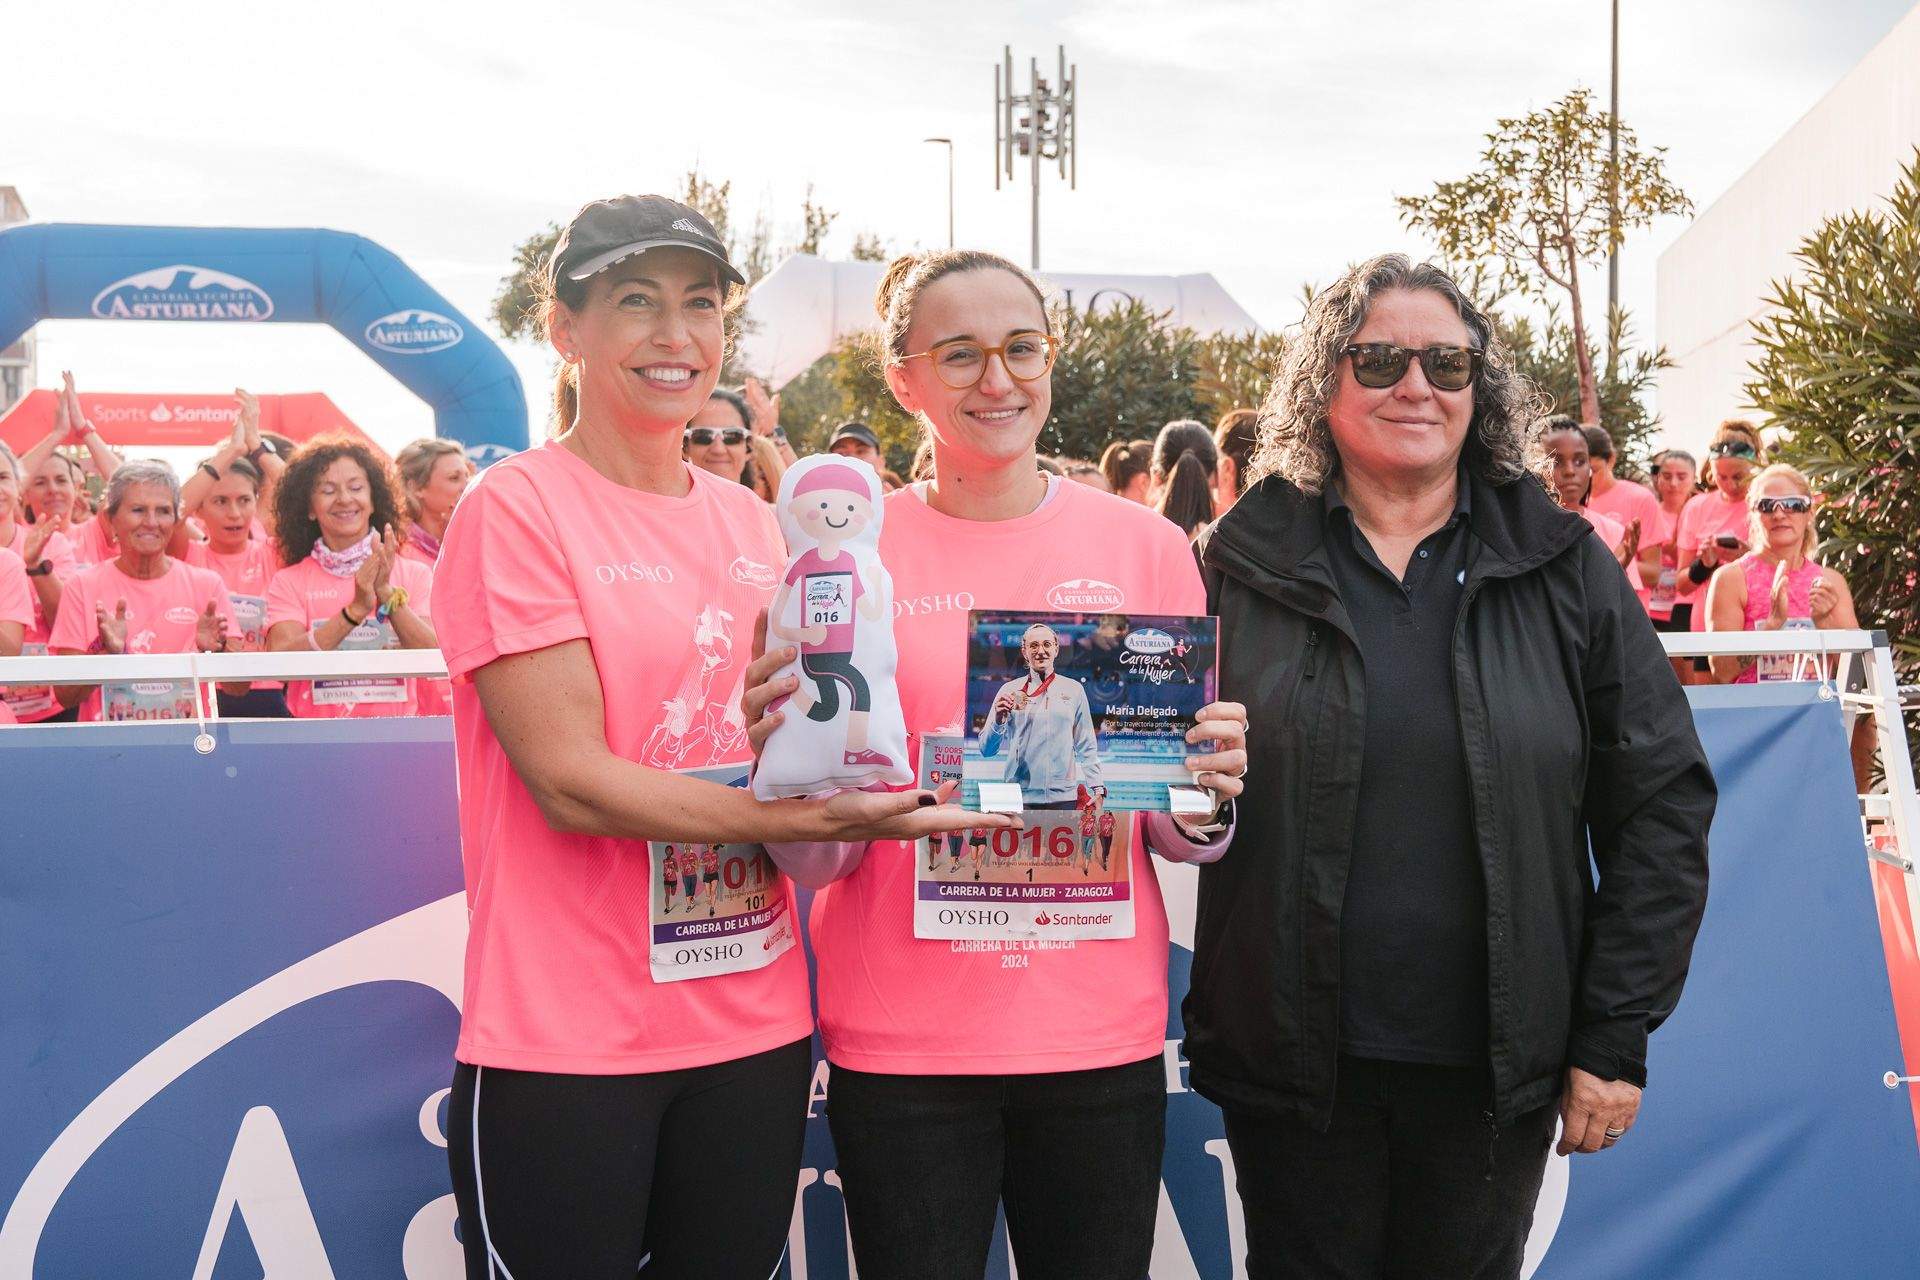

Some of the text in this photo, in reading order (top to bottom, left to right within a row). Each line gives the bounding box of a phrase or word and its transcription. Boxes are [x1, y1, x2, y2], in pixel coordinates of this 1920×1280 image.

[110, 295, 259, 318] ASTURIANA
[94, 404, 241, 422] Sports Santan
[1054, 591, 1120, 605] ASTURIANA
[814, 611, 839, 623] 016
[1128, 636, 1172, 649] ASTURIANA
[1119, 651, 1161, 665] Carrera
[1129, 664, 1176, 685] de la Mujer
[1105, 704, 1178, 718] María Delgado
[934, 754, 963, 766] SUM
[942, 771, 963, 780] Zarag
[992, 826, 1075, 859] 016
[723, 854, 765, 890] 01
[1026, 868, 1033, 882] 1
[940, 885, 1114, 898] CARRERA DE LA MUJER ZARAGOZA
[745, 894, 765, 911] 101
[938, 909, 1113, 926] OYSHO Santander
[675, 922, 722, 937] CARRERA
[724, 920, 736, 931] DE
[738, 917, 750, 927] LA
[675, 943, 743, 965] OYSHO
[1001, 954, 1029, 968] 2024
